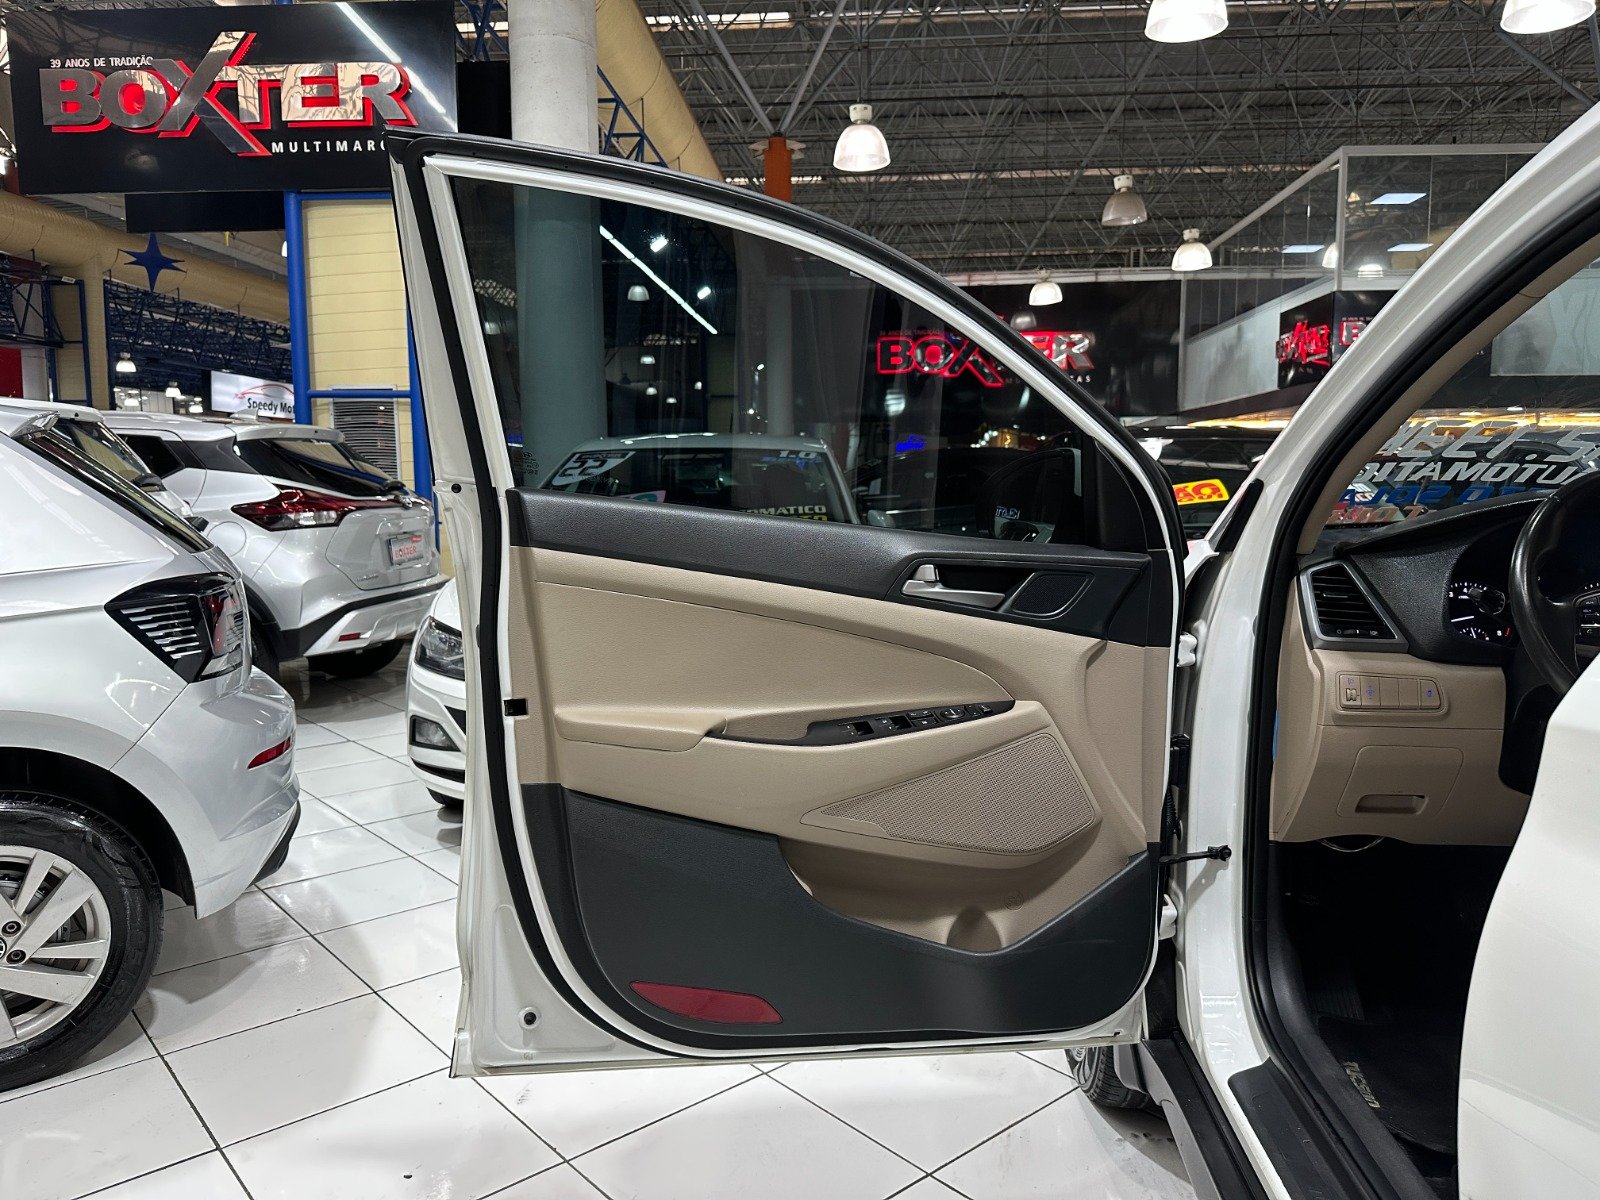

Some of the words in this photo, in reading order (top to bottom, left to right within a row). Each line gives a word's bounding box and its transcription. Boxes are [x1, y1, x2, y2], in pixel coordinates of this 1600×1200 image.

[49, 59, 61, 68] 39
[64, 58, 91, 68] ANOS
[93, 57, 106, 67] DE
[109, 54, 154, 68] TRADIÇÃO
[39, 31, 419, 157] BOXTER
[876, 328, 1096, 388] BOXER
[247, 398, 279, 414] Speedy
[779, 450, 818, 459] 1.0
[558, 459, 608, 478] 22
